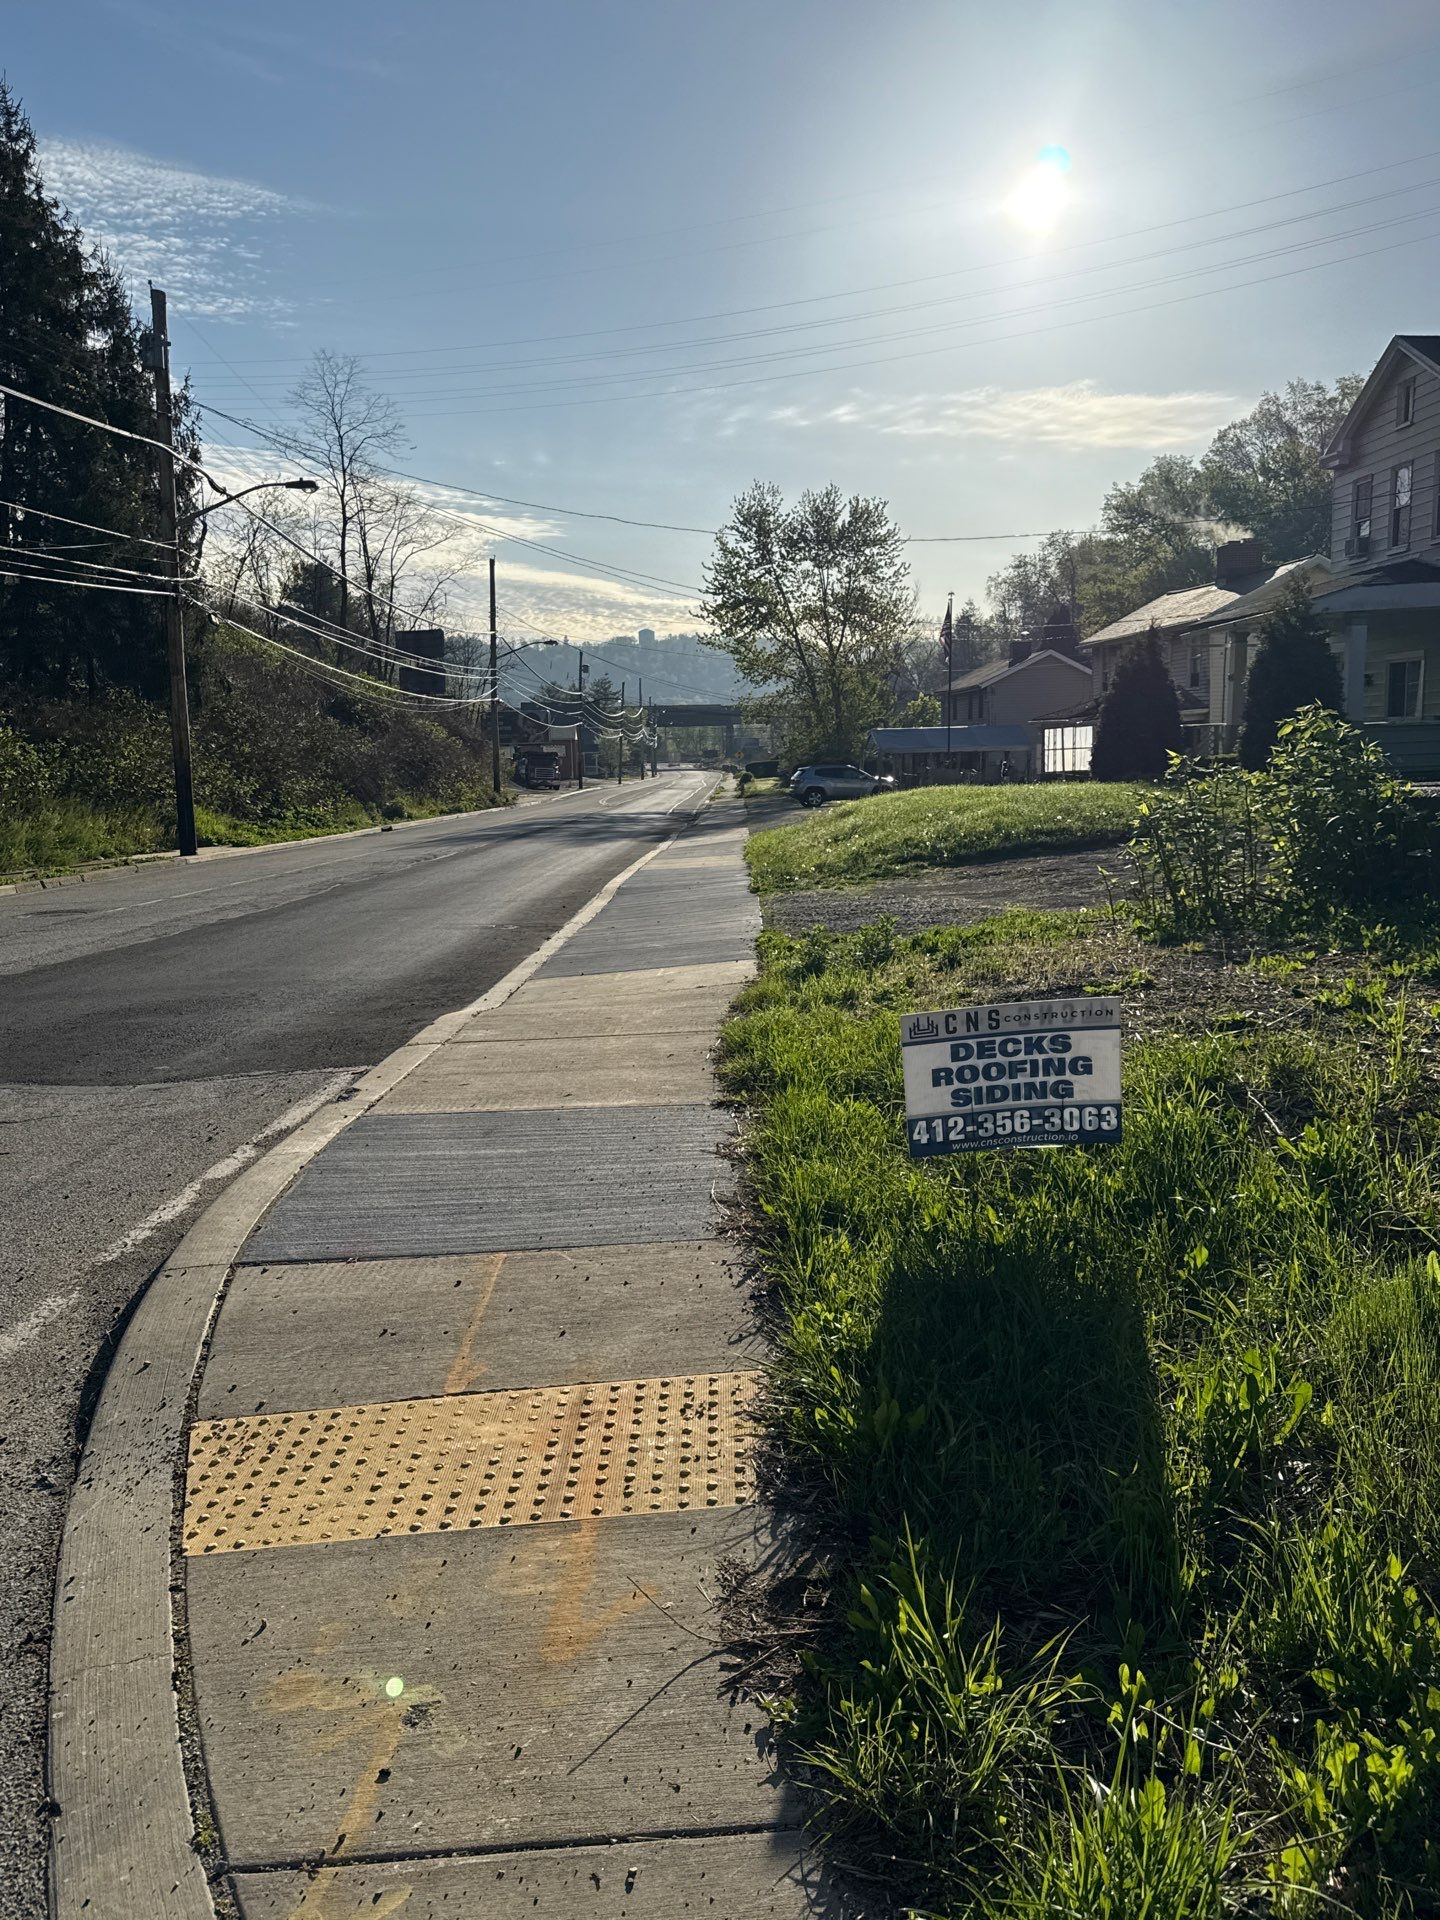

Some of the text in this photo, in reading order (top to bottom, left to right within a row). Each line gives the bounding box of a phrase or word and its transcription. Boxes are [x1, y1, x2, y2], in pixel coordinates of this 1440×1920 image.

[1004, 1009, 1113, 1023] CONSTRUCTION
[950, 1034, 1072, 1062] DECKS
[932, 1056, 1093, 1087] ROOFING
[951, 1080, 1074, 1107] SIDING
[913, 1106, 1118, 1144] 412-356-3063
[952, 1133, 1078, 1150] www.cnsconstruction.io
